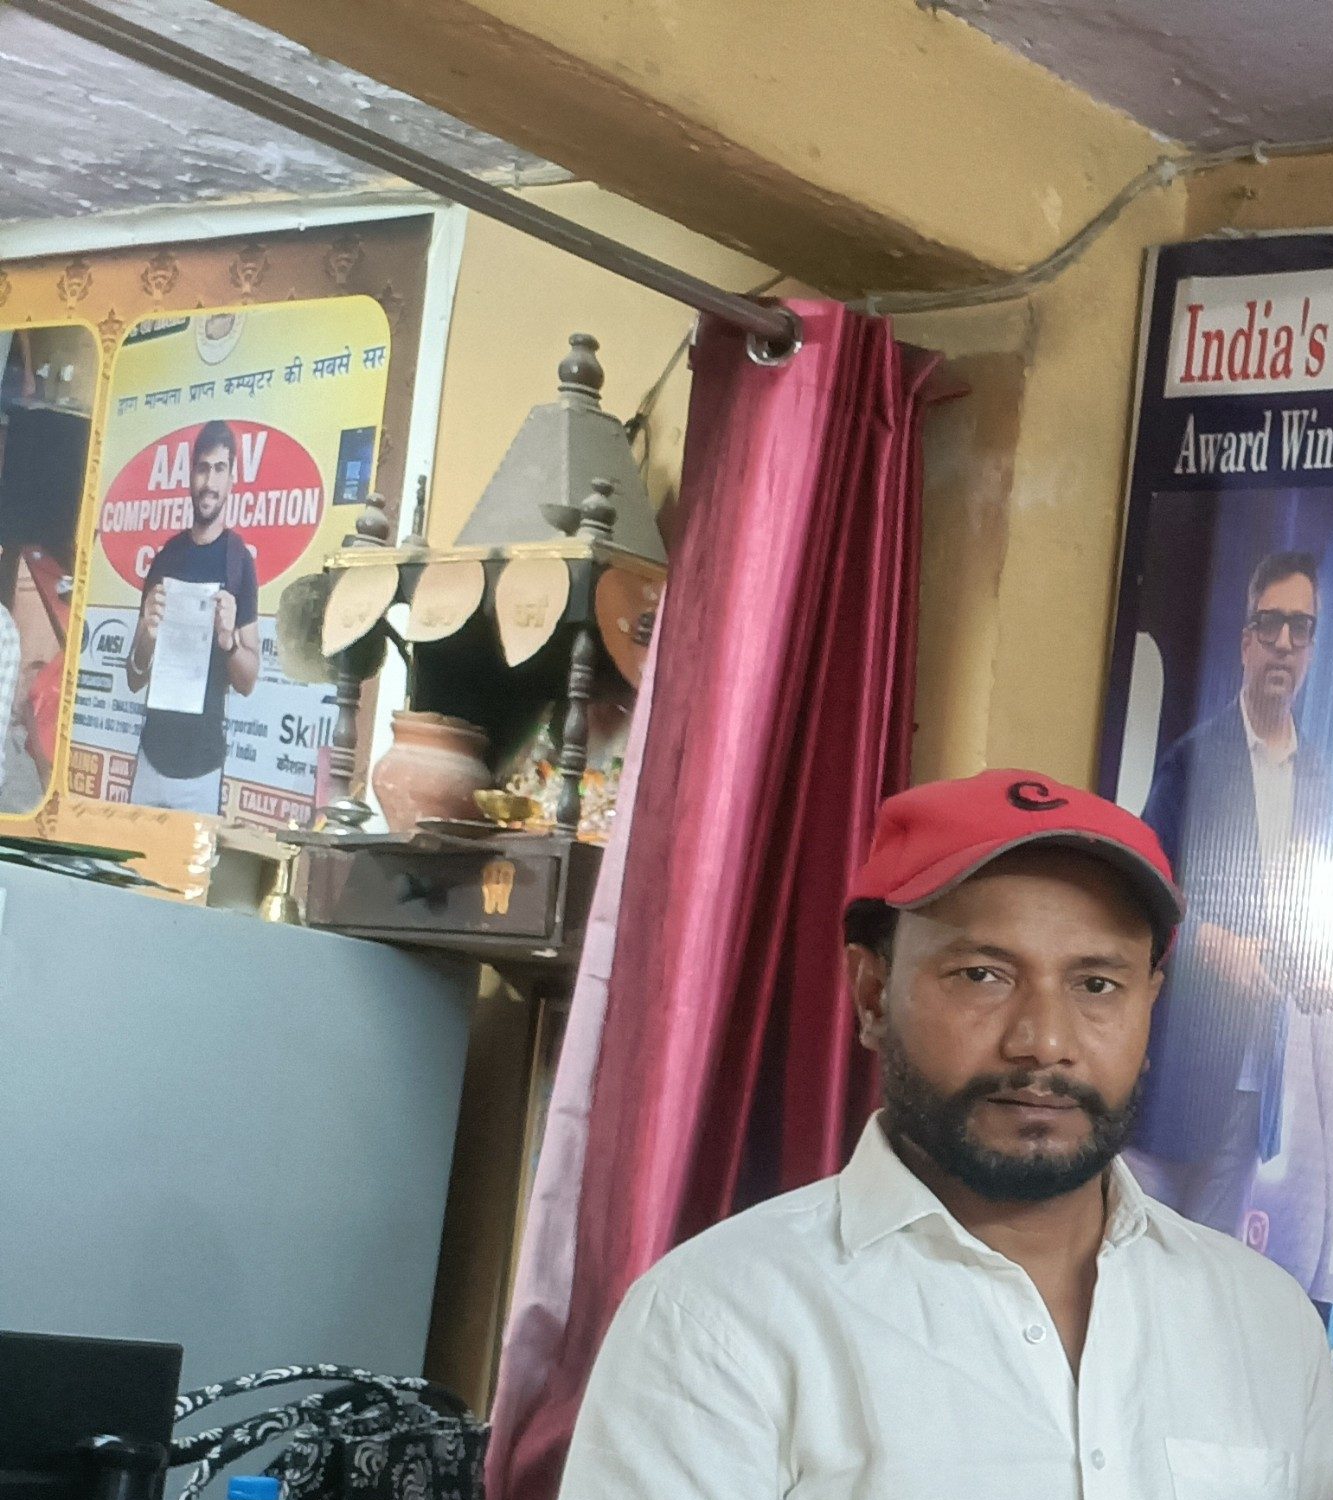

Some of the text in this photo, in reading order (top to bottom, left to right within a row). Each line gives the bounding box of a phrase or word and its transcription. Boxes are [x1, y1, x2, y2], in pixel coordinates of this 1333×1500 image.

[1180, 298, 1329, 383] India's
[284, 356, 302, 383] की
[312, 345, 351, 379] सबसे
[148, 431, 267, 491] AAV
[1175, 411, 1272, 475] Award
[102, 487, 320, 533] COMPUTER UCATION
[97, 635, 125, 653] ANSI
[241, 787, 277, 813] TALLY
